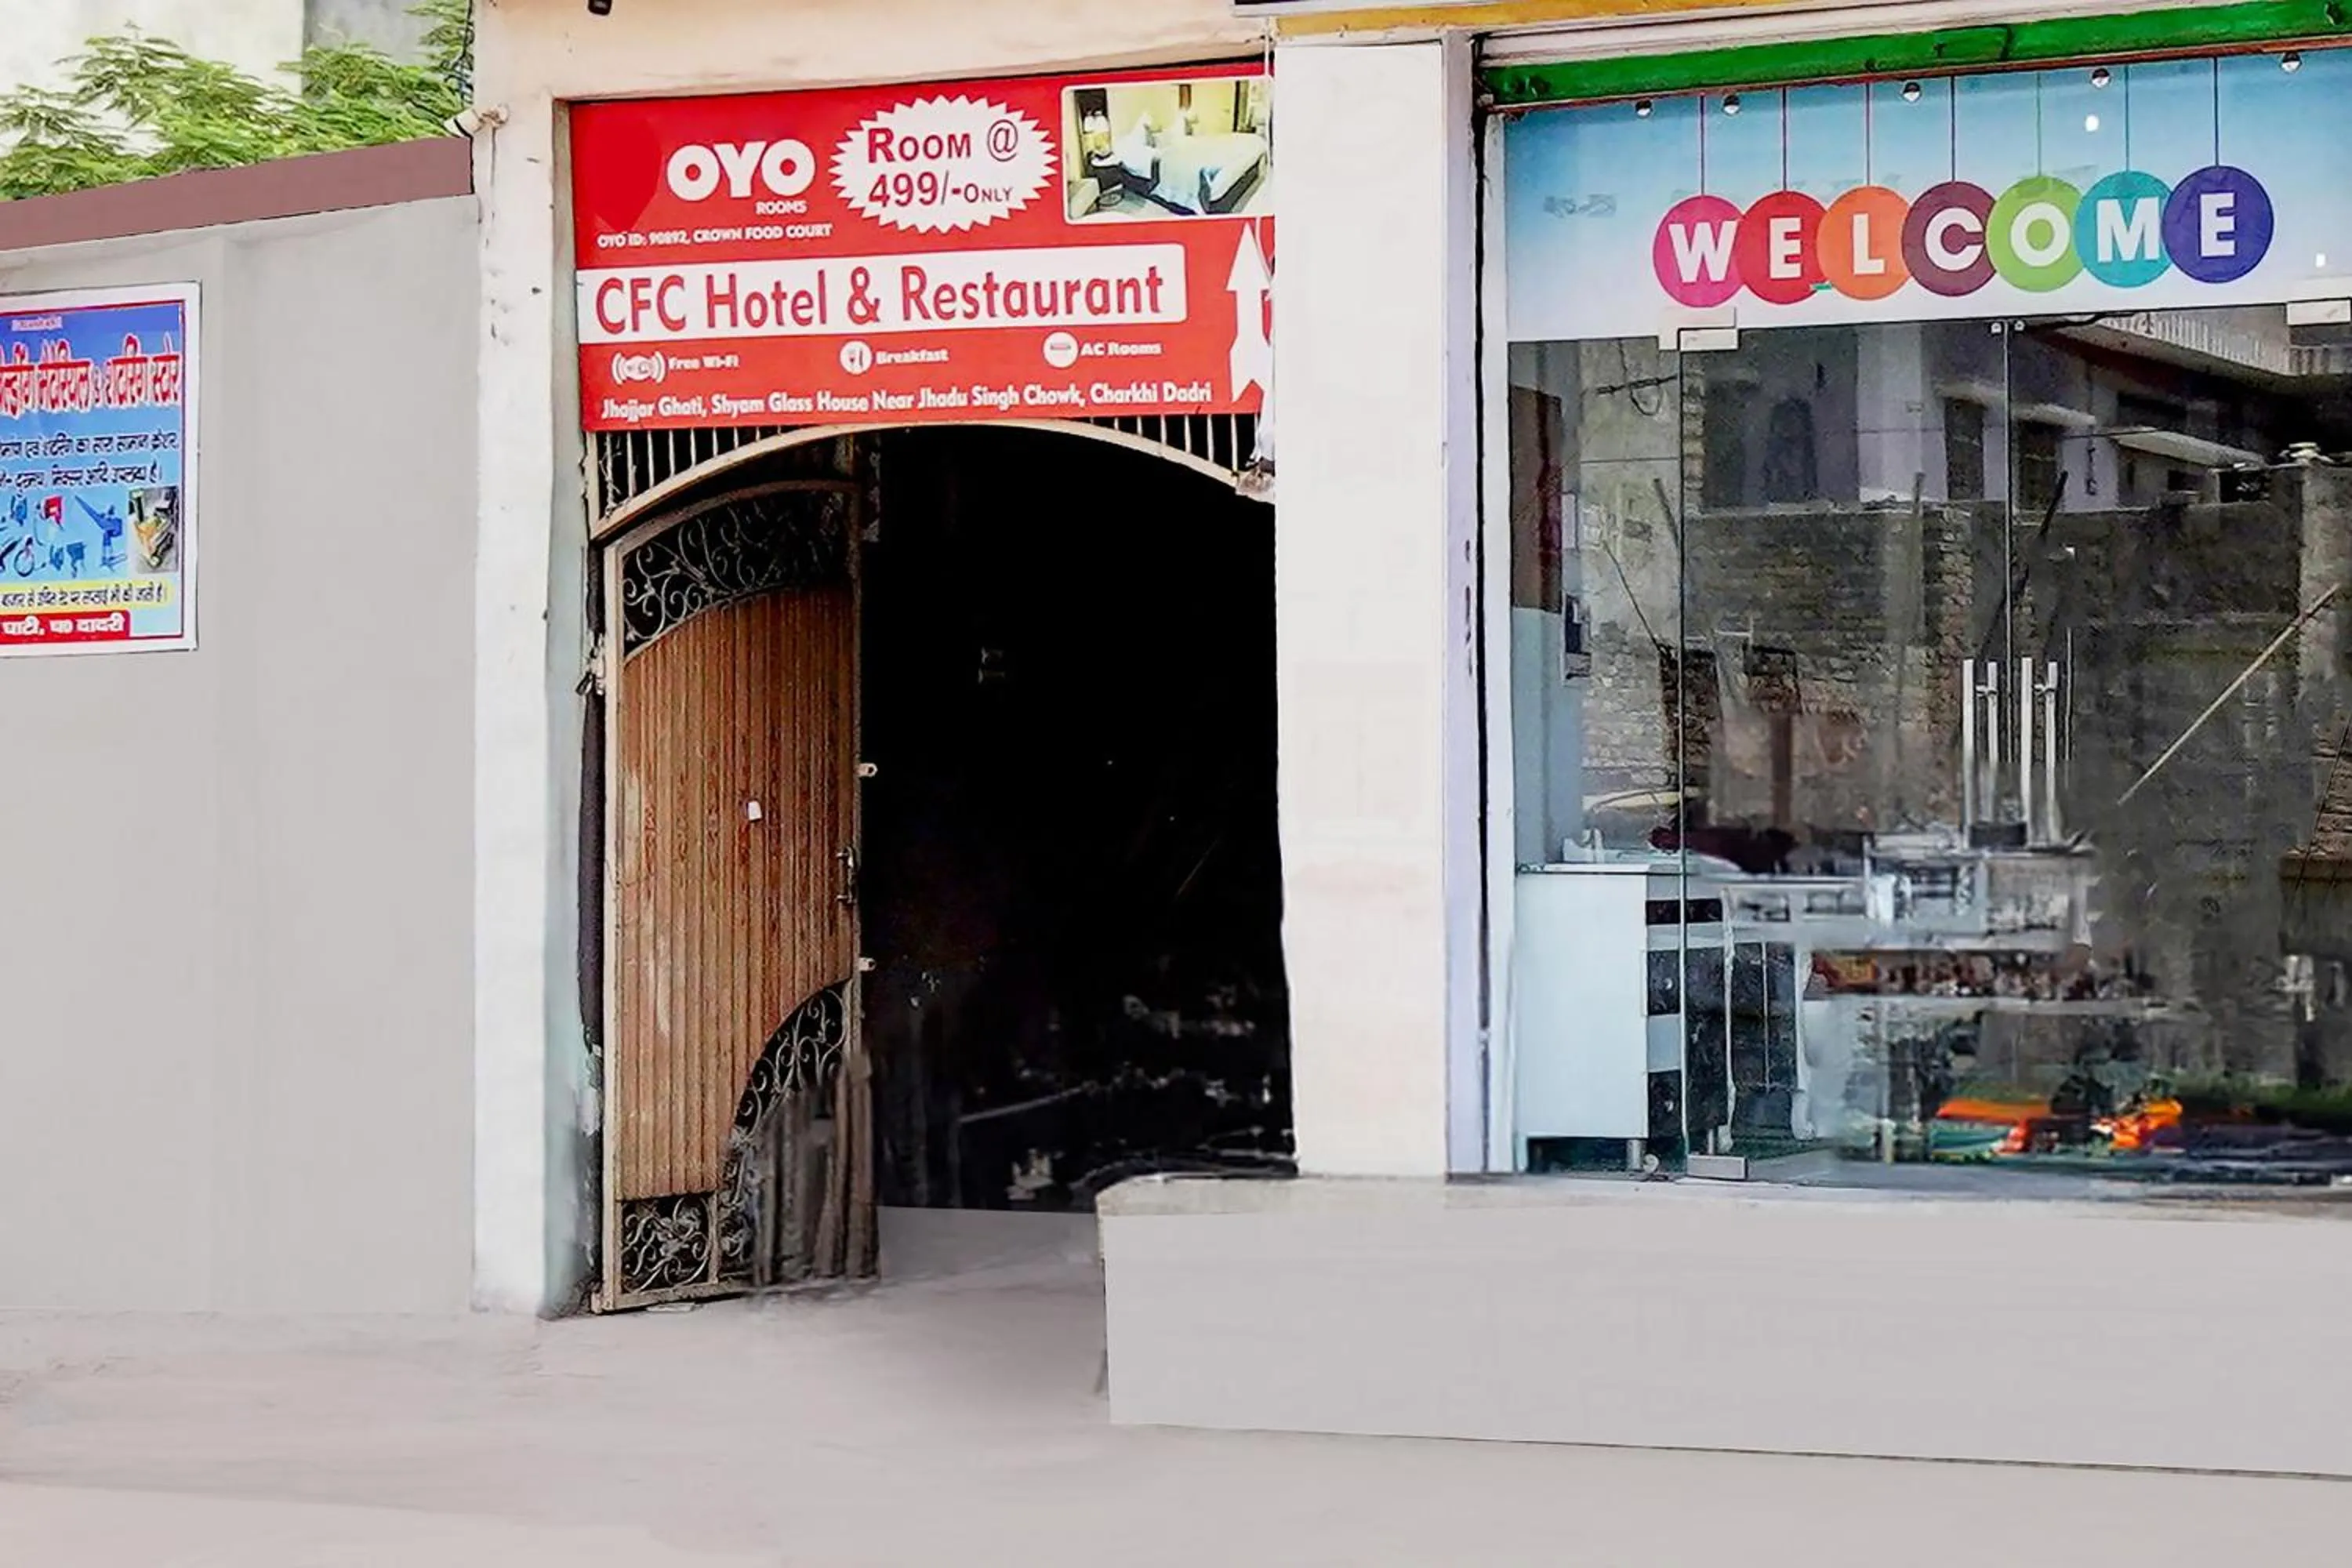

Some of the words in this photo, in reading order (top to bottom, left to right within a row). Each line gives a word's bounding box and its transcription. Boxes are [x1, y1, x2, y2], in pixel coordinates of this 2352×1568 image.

[987, 119, 1018, 162] @
[666, 139, 816, 201] OYO
[755, 201, 808, 215] ROOMS
[597, 232, 626, 248] OYO
[693, 228, 742, 243] CROWN
[745, 226, 783, 239] FOOD
[786, 223, 833, 238] COURT
[1669, 193, 2238, 283] WELCOME
[596, 274, 687, 335] CFC
[705, 269, 827, 328] Hotel
[847, 266, 880, 325] &
[901, 265, 1163, 322] Restaurant
[668, 357, 700, 370] Free
[876, 349, 949, 365] Breakfast
[1080, 342, 1105, 356] AC
[1107, 341, 1162, 356] Rooms
[601, 398, 655, 423] Jhajjar
[658, 395, 707, 417] Ghati,
[711, 393, 765, 419] Shyam
[768, 391, 813, 412] Glass
[816, 390, 869, 411] House
[872, 389, 914, 410] Near
[917, 386, 968, 409] Jhadu
[971, 384, 1020, 411] Singh
[1023, 382, 1086, 408] Chowk,
[1091, 382, 1158, 404] Charkhi
[1163, 381, 1212, 402] Dadri
